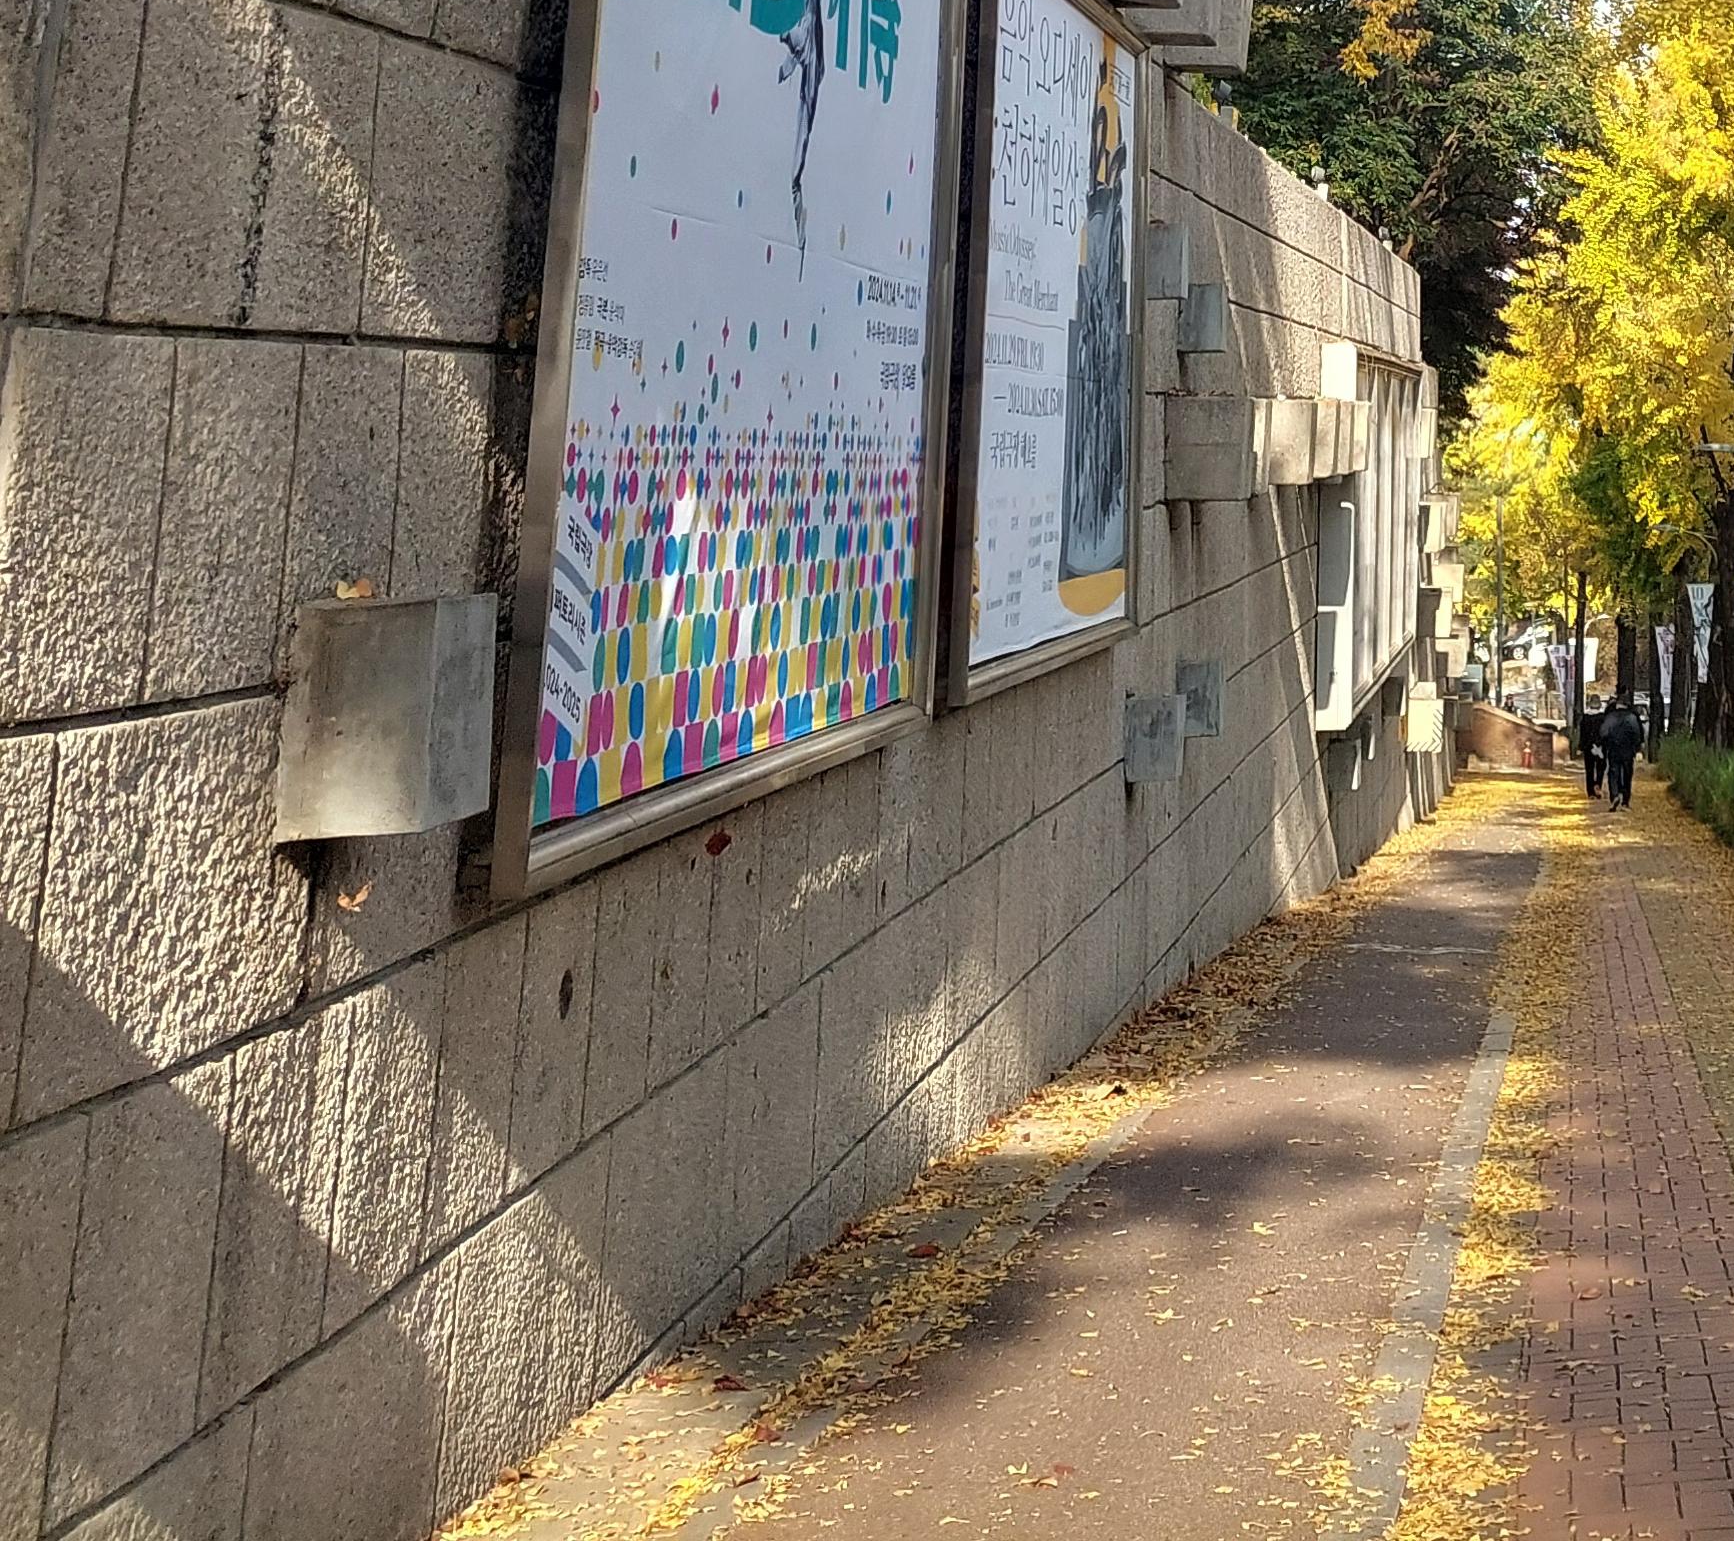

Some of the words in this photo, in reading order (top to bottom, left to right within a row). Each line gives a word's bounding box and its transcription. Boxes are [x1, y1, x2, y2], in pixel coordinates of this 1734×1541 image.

[1036, 17, 1093, 134] 오디세이
[567, 515, 593, 570] 국립극장
[544, 663, 581, 724] 024-2025
